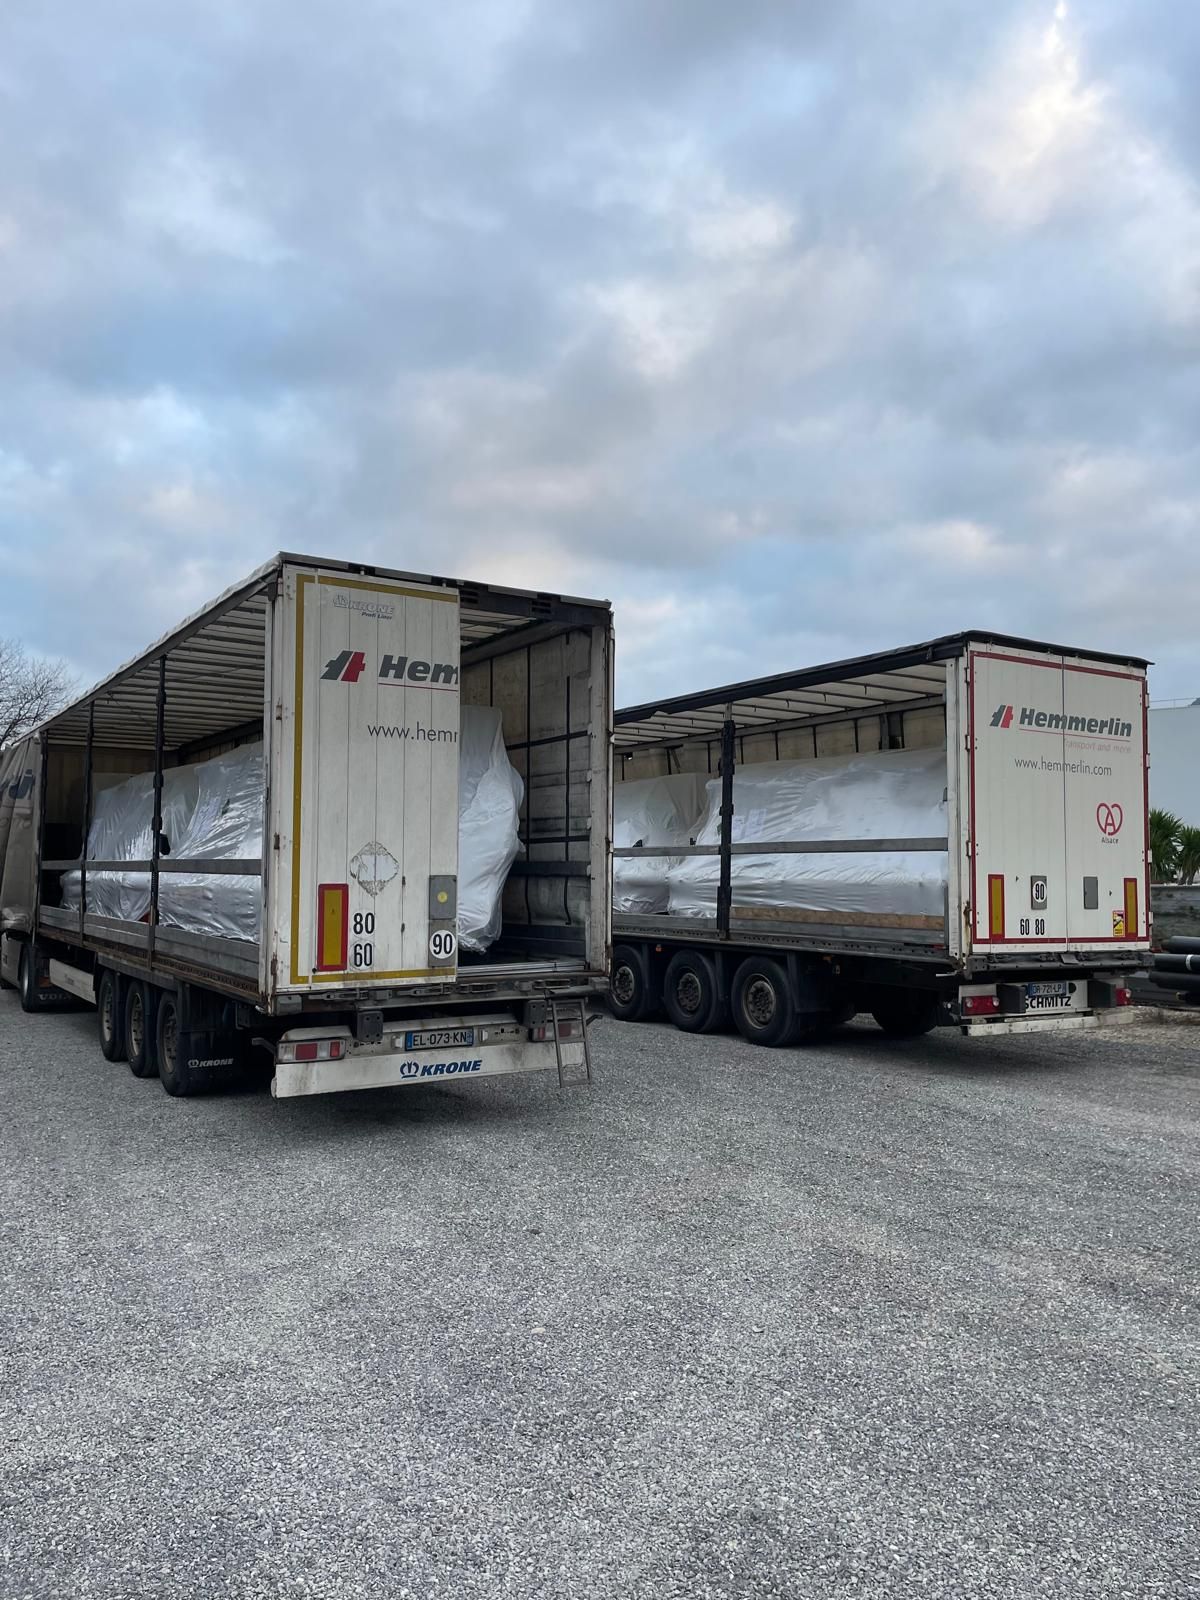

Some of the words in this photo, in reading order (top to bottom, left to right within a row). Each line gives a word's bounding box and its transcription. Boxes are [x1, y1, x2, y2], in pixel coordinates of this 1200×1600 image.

[367, 721, 458, 743] www.hem
[1019, 707, 1132, 737] Hemmerlin
[1014, 756, 1113, 777] www.hemmerlin.com
[1035, 883, 1045, 900] 90
[353, 912, 375, 935] 80
[1020, 918, 1030, 936] 60
[1035, 918, 1045, 936] 80
[433, 933, 453, 955] 90
[353, 943, 373, 968] 60
[420, 1060, 482, 1077] KRONE
